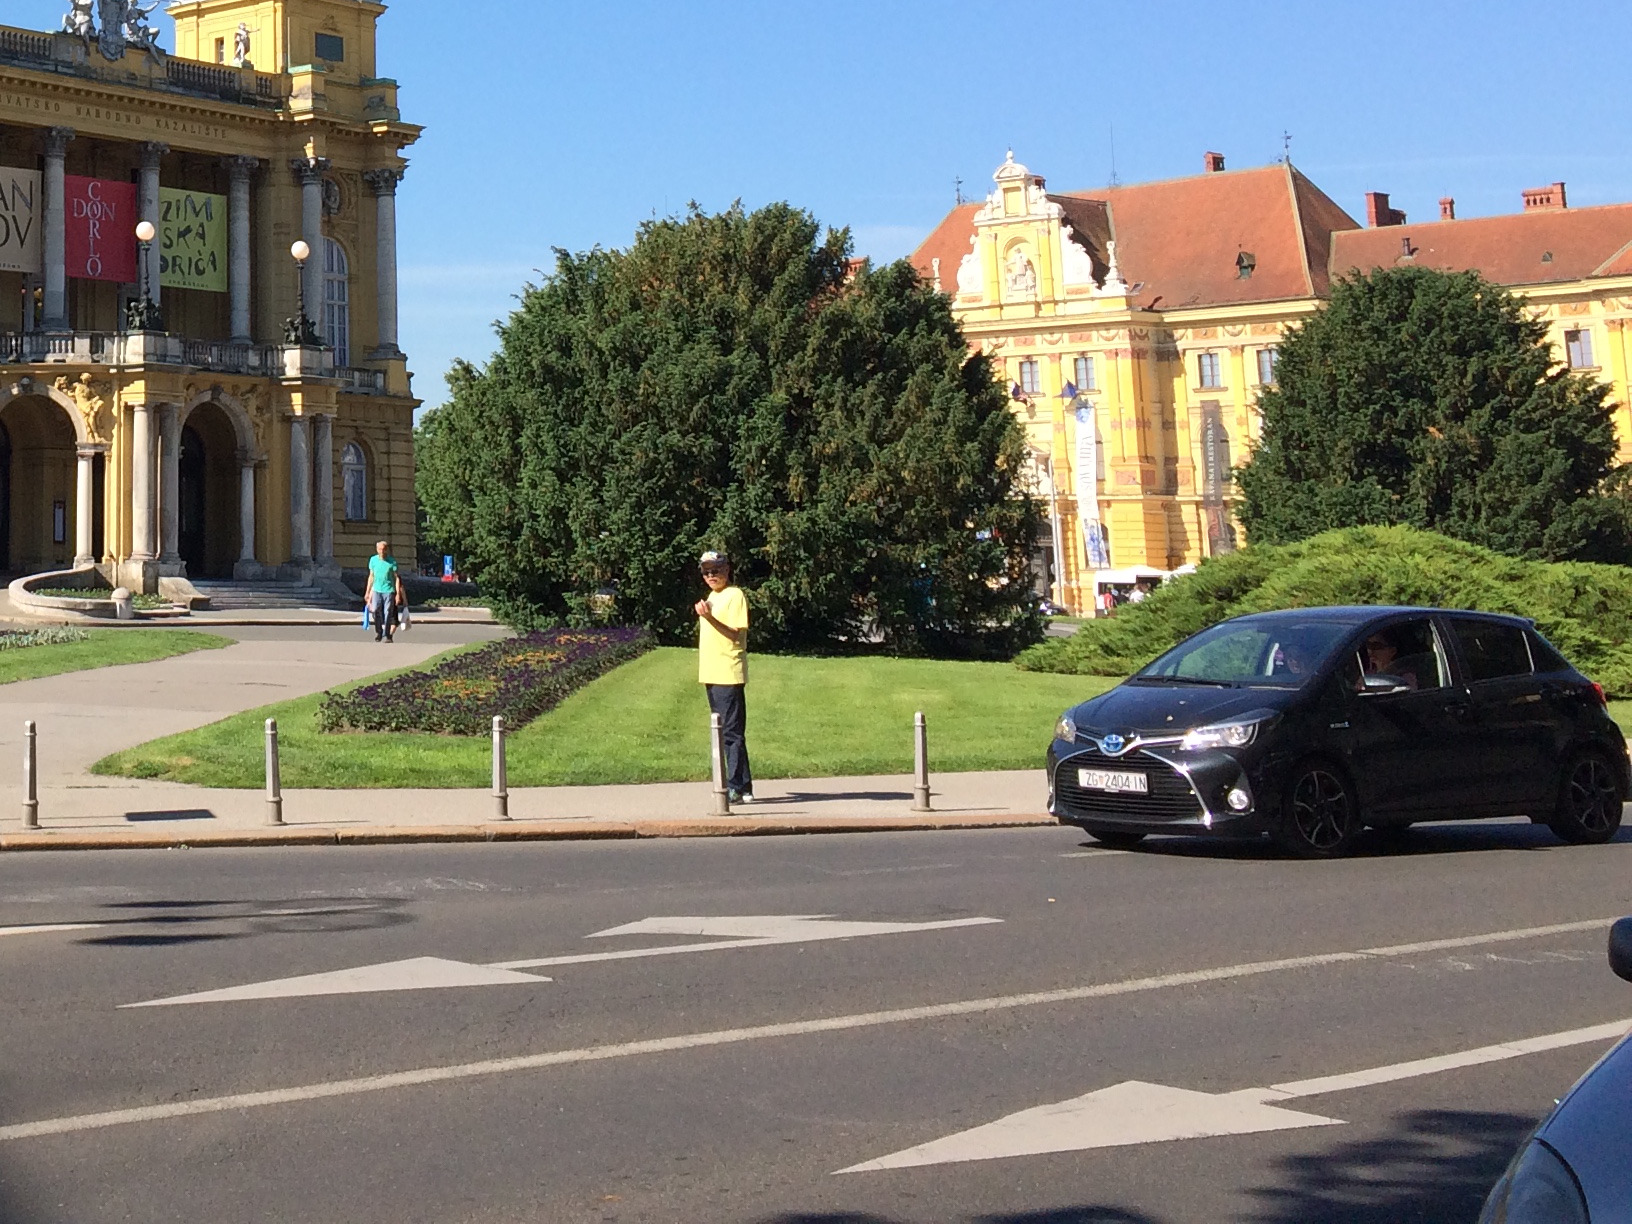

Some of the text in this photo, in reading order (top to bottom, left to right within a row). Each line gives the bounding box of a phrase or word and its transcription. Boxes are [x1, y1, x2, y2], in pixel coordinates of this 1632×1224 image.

[76, 104, 141, 125] NARODNO
[73, 198, 116, 222] DON
[161, 194, 214, 222] ZIM
[162, 222, 207, 250] SKA
[1207, 417, 1215, 462] RESTORAN
[1208, 468, 1216, 501] KAVANA
[1086, 772, 1099, 787] ZG
